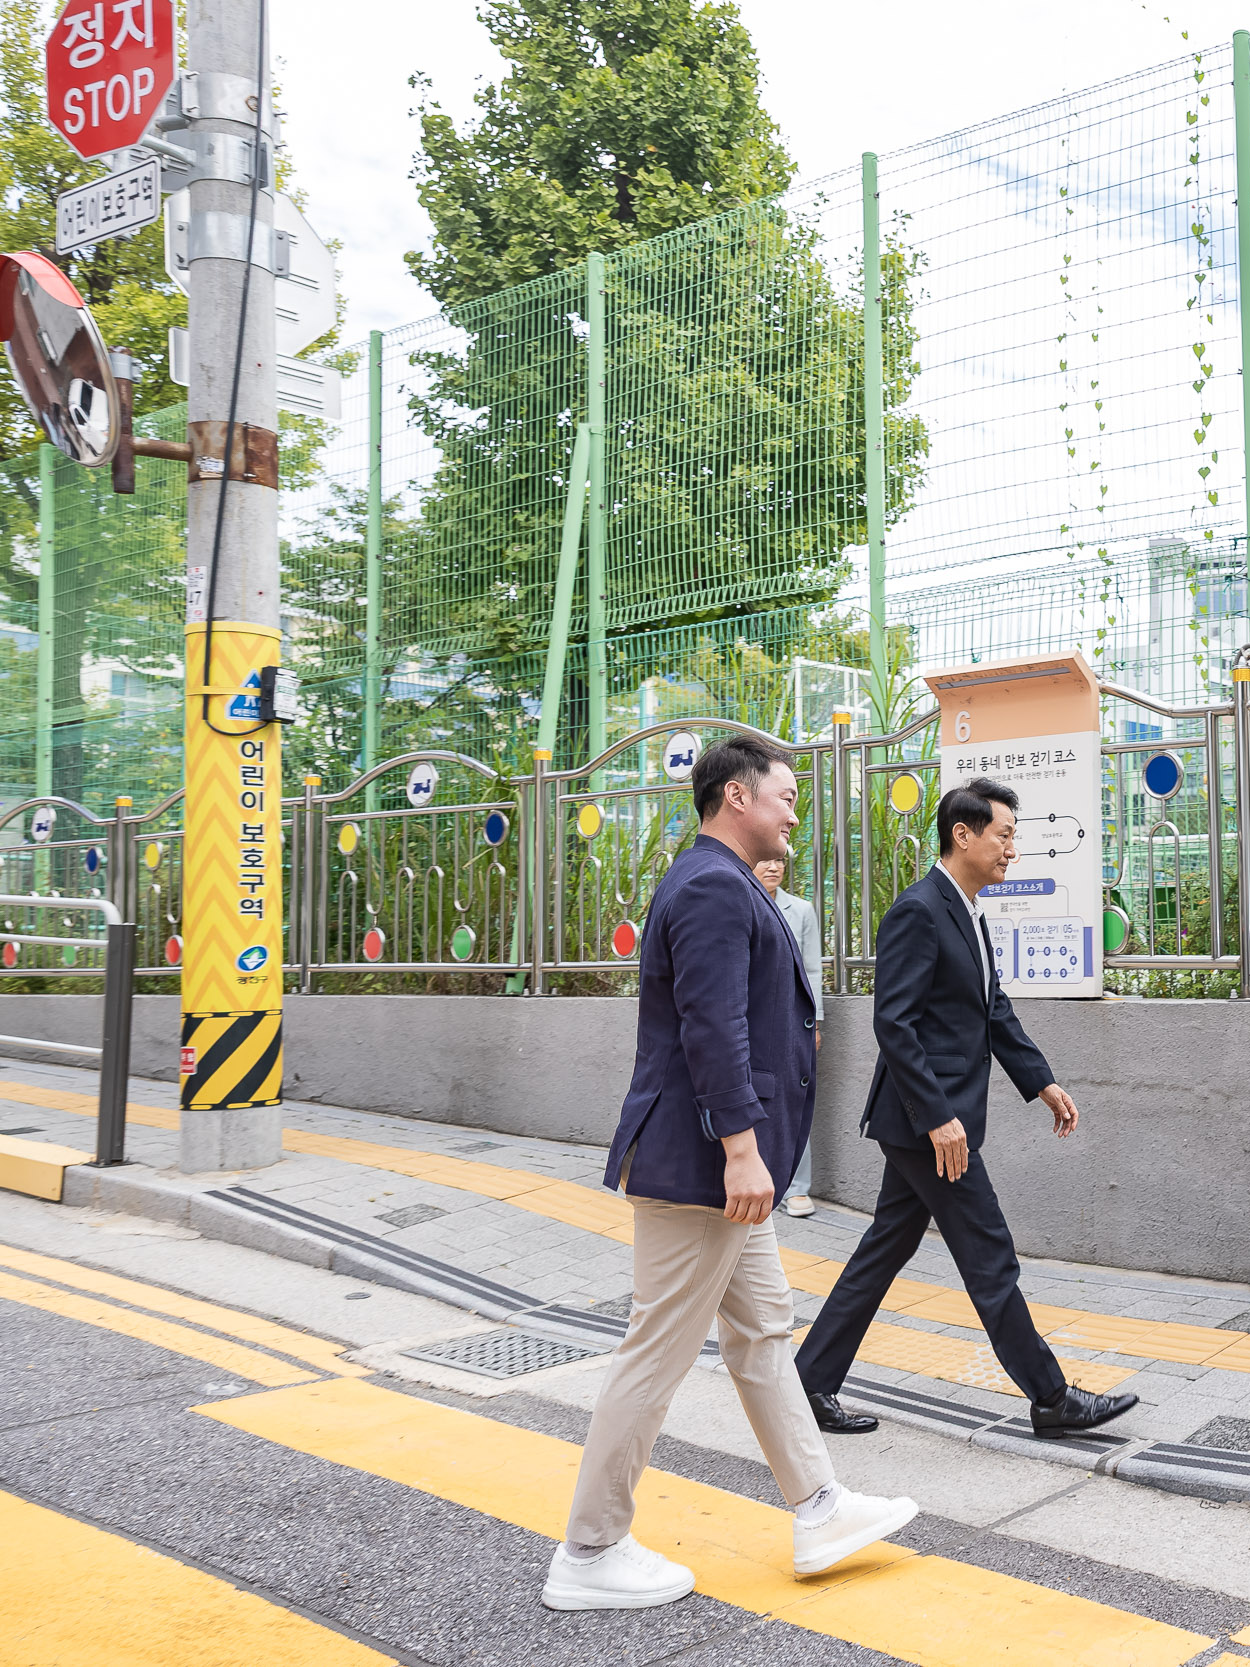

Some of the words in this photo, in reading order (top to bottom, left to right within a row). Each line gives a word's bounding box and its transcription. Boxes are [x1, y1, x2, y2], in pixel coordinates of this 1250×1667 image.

[62, 0, 154, 69] 정지
[64, 67, 155, 134] STOP
[63, 170, 155, 239] 어린이보호구역
[955, 710, 971, 743] 6
[240, 741, 264, 812] 어린이
[956, 757, 976, 773] 우리
[979, 755, 1001, 772] 동네
[1004, 753, 1027, 769] 만보
[1030, 750, 1051, 767] 걷기
[1053, 749, 1077, 763] 코스
[239, 823, 265, 919] 보호구역
[987, 883, 1015, 895] 만보걷기
[1015, 882, 1044, 893] 코스소개
